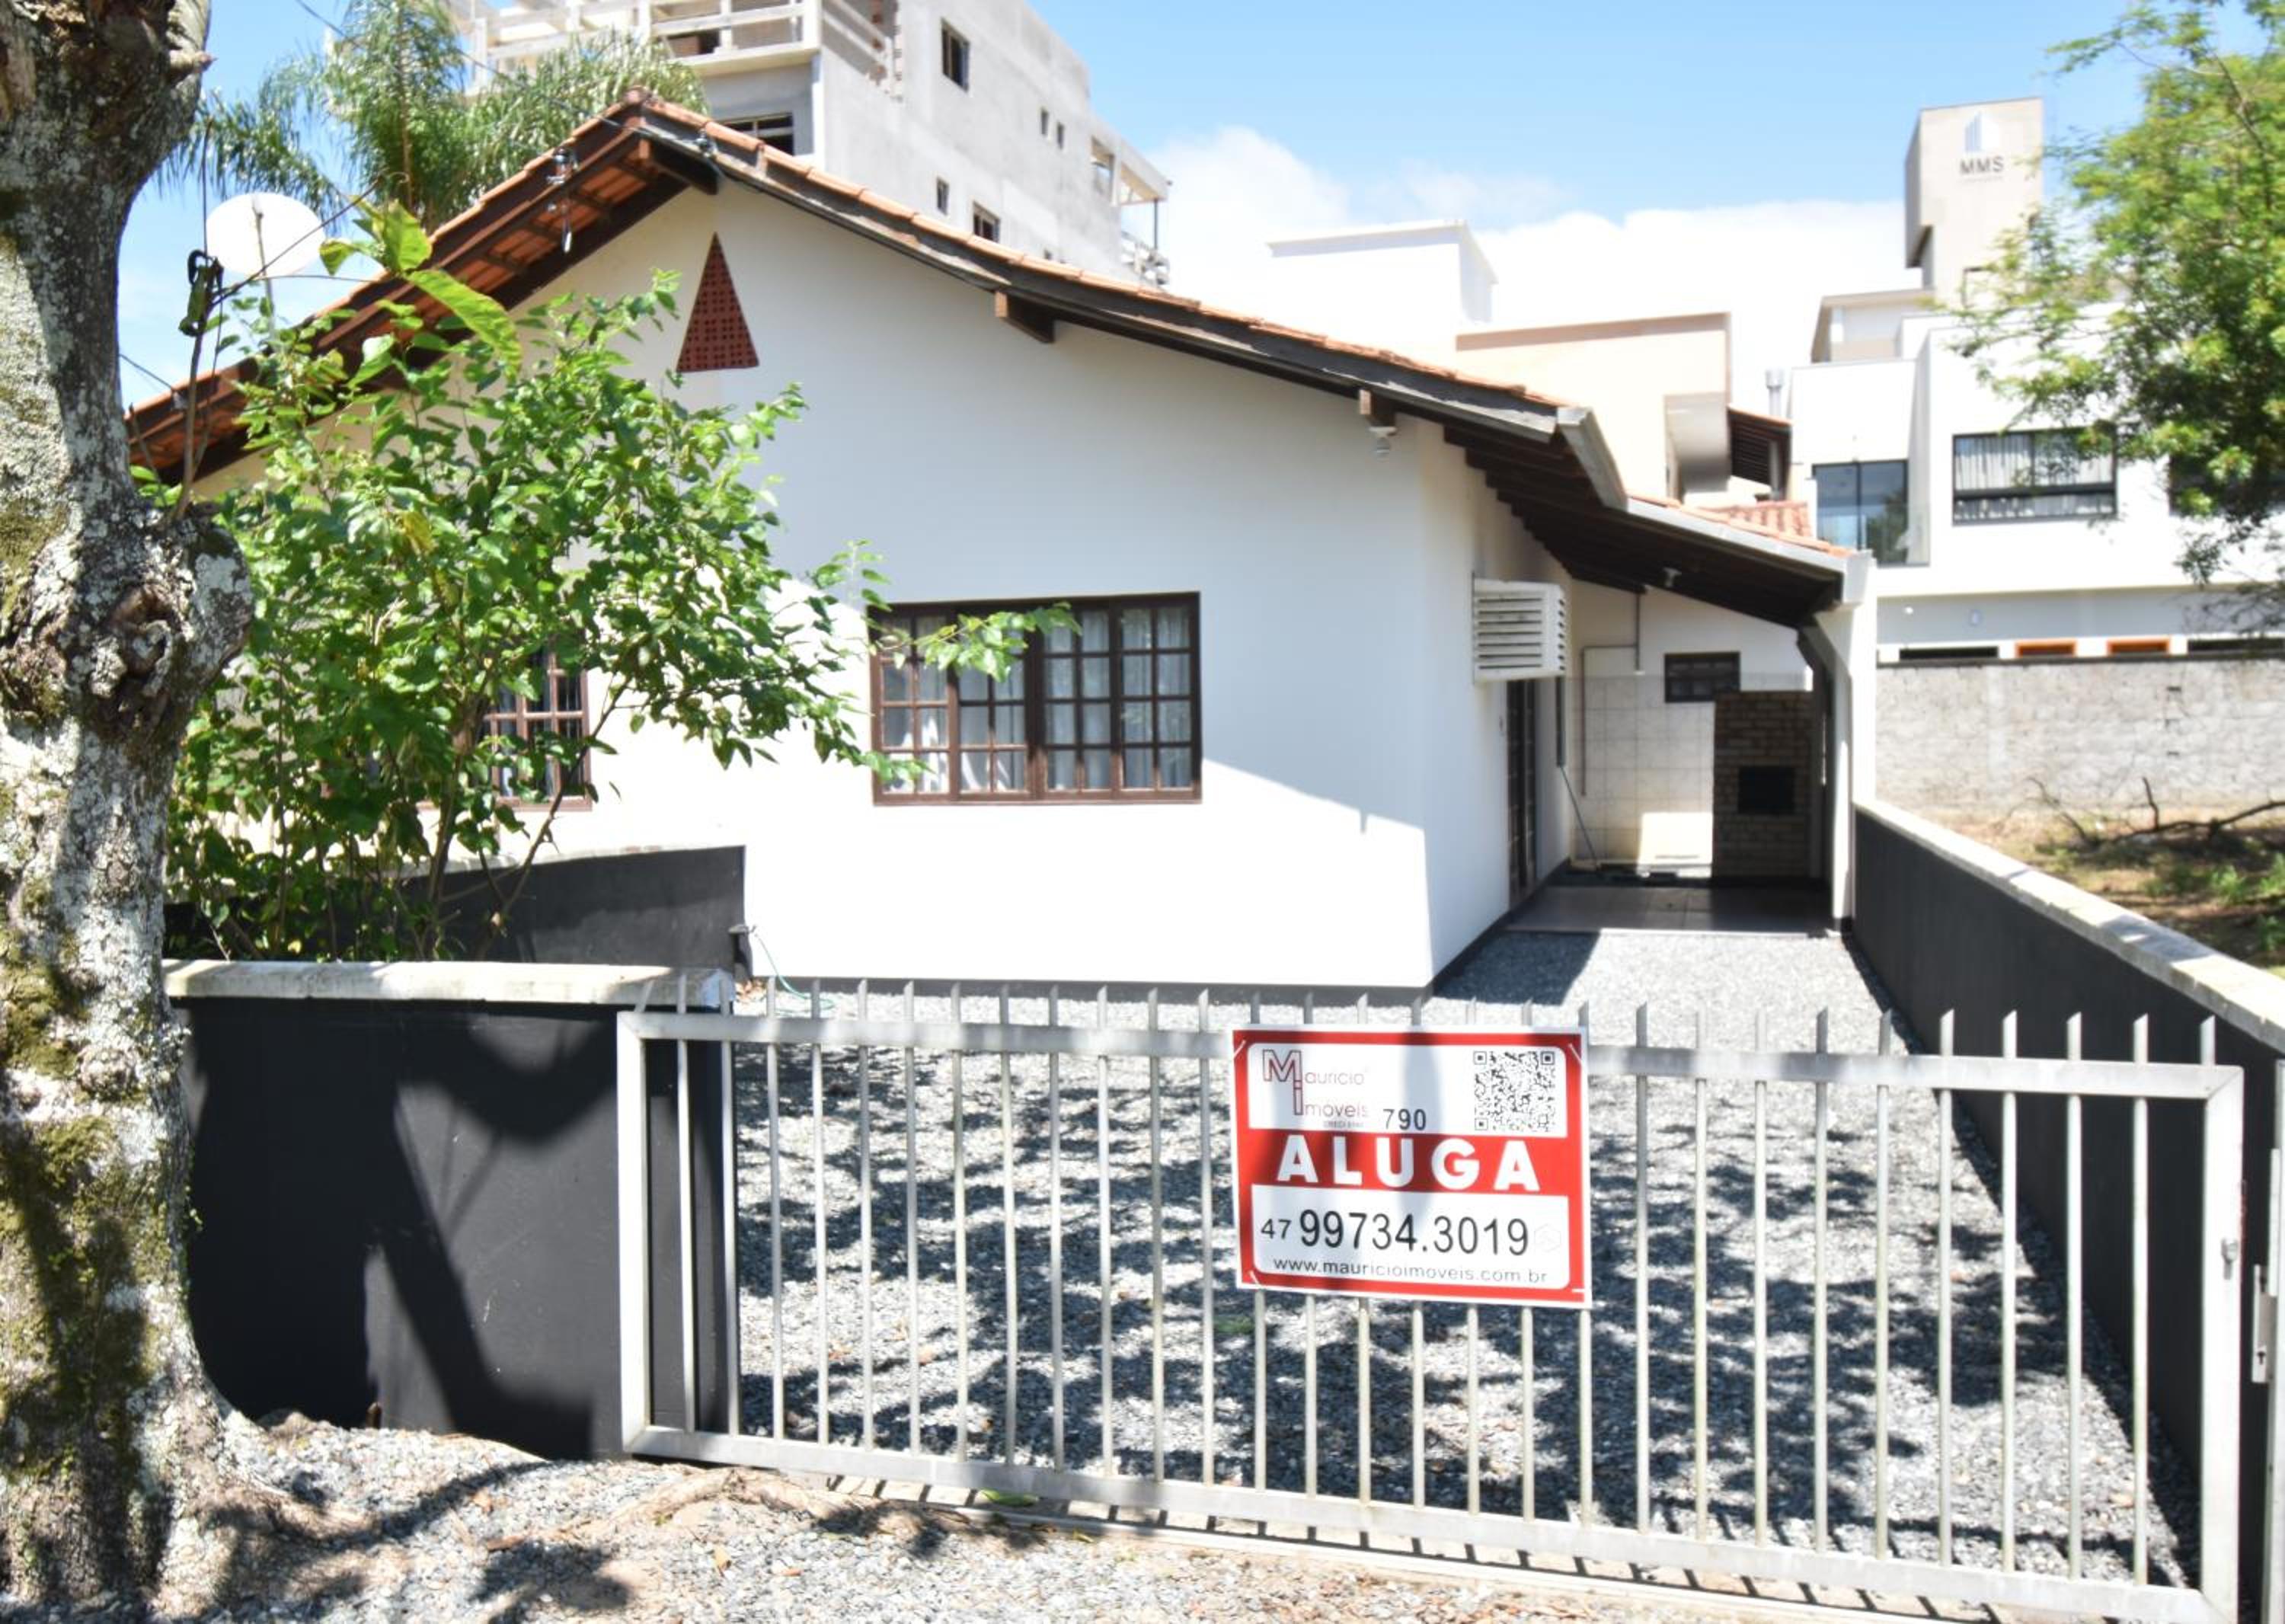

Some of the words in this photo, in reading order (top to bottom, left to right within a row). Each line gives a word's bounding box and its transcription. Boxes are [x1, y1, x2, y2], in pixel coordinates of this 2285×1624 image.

[1961, 156, 2004, 174] MMS
[1382, 1108, 1427, 1131] 790
[1277, 1134, 1540, 1191] ALUGA
[1261, 1219, 1292, 1239] 47
[1299, 1209, 1529, 1257] 99734.3019
[1274, 1258, 1547, 1284] www.mauricioimoveis.com.br
